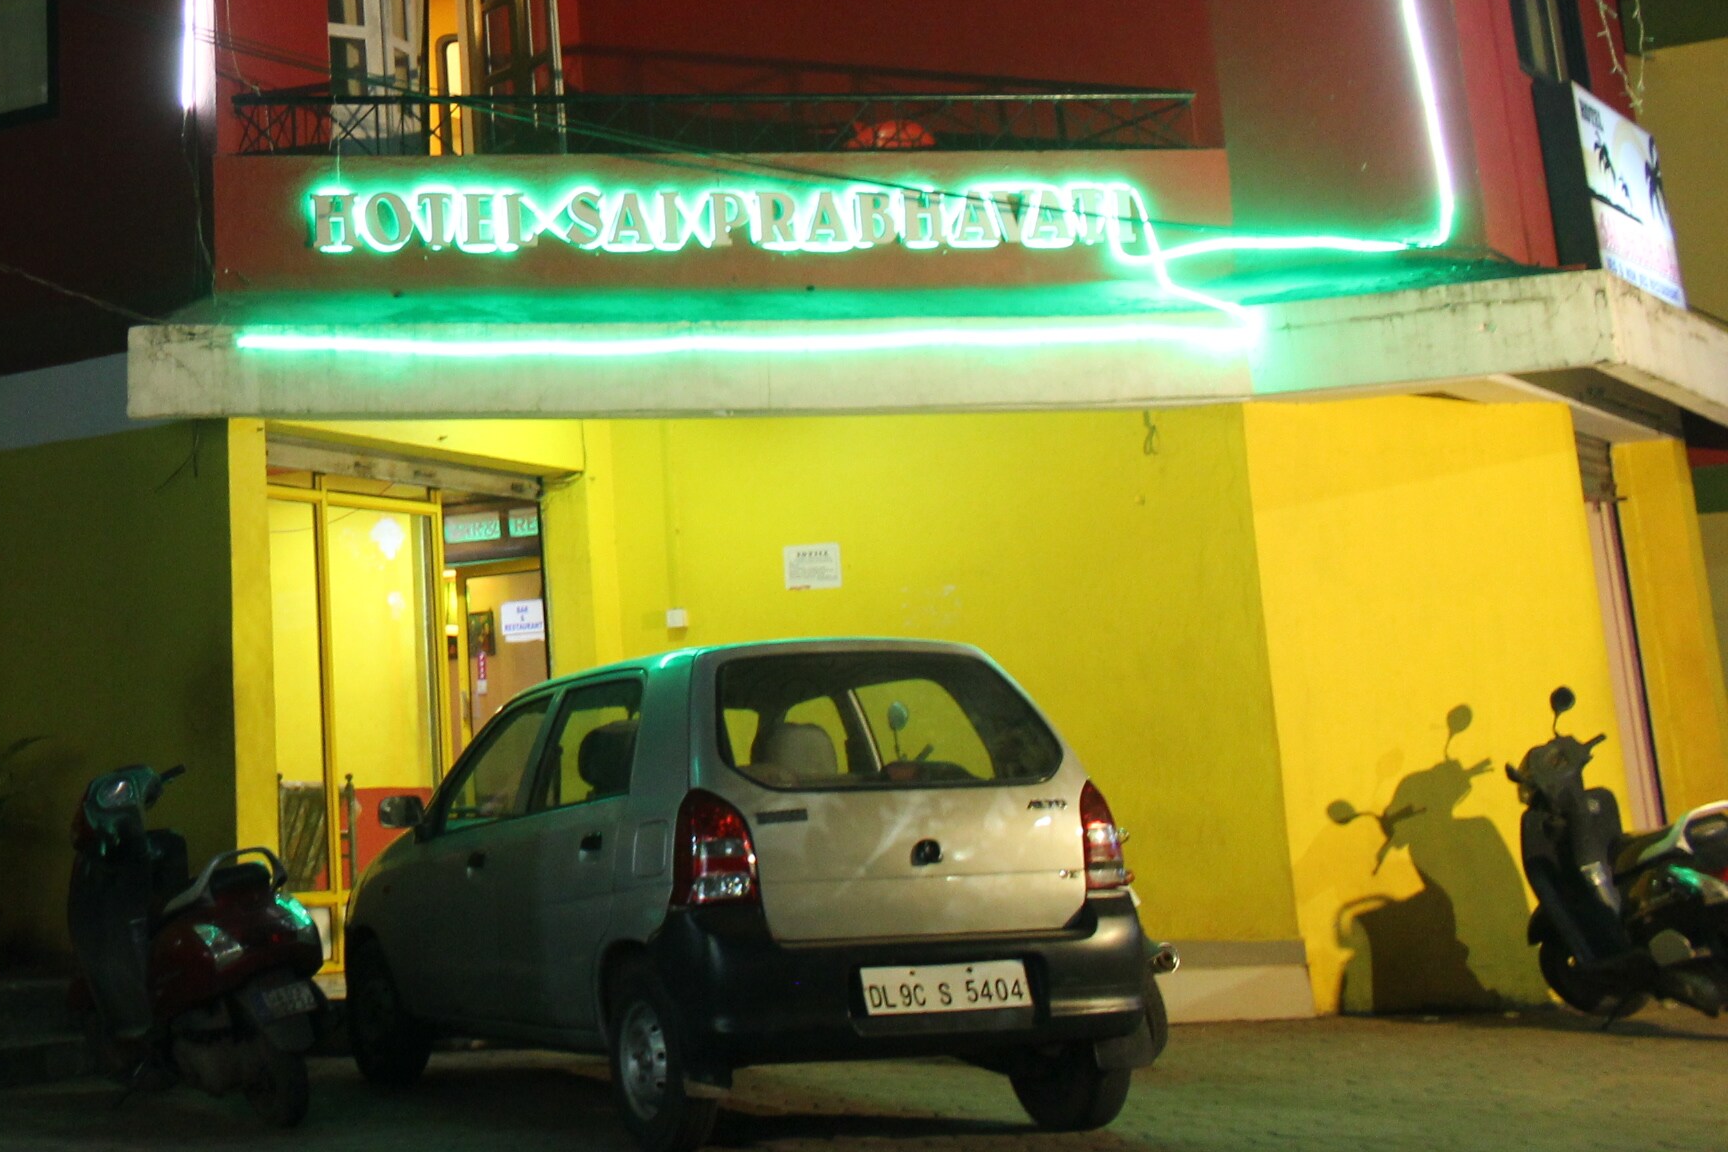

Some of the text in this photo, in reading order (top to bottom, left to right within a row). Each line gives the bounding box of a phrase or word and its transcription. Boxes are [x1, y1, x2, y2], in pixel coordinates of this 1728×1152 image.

[310, 186, 1138, 251] HOTEL SAI PRABHAVATI
[938, 982, 953, 1006] S
[965, 978, 1024, 1003] 5404
